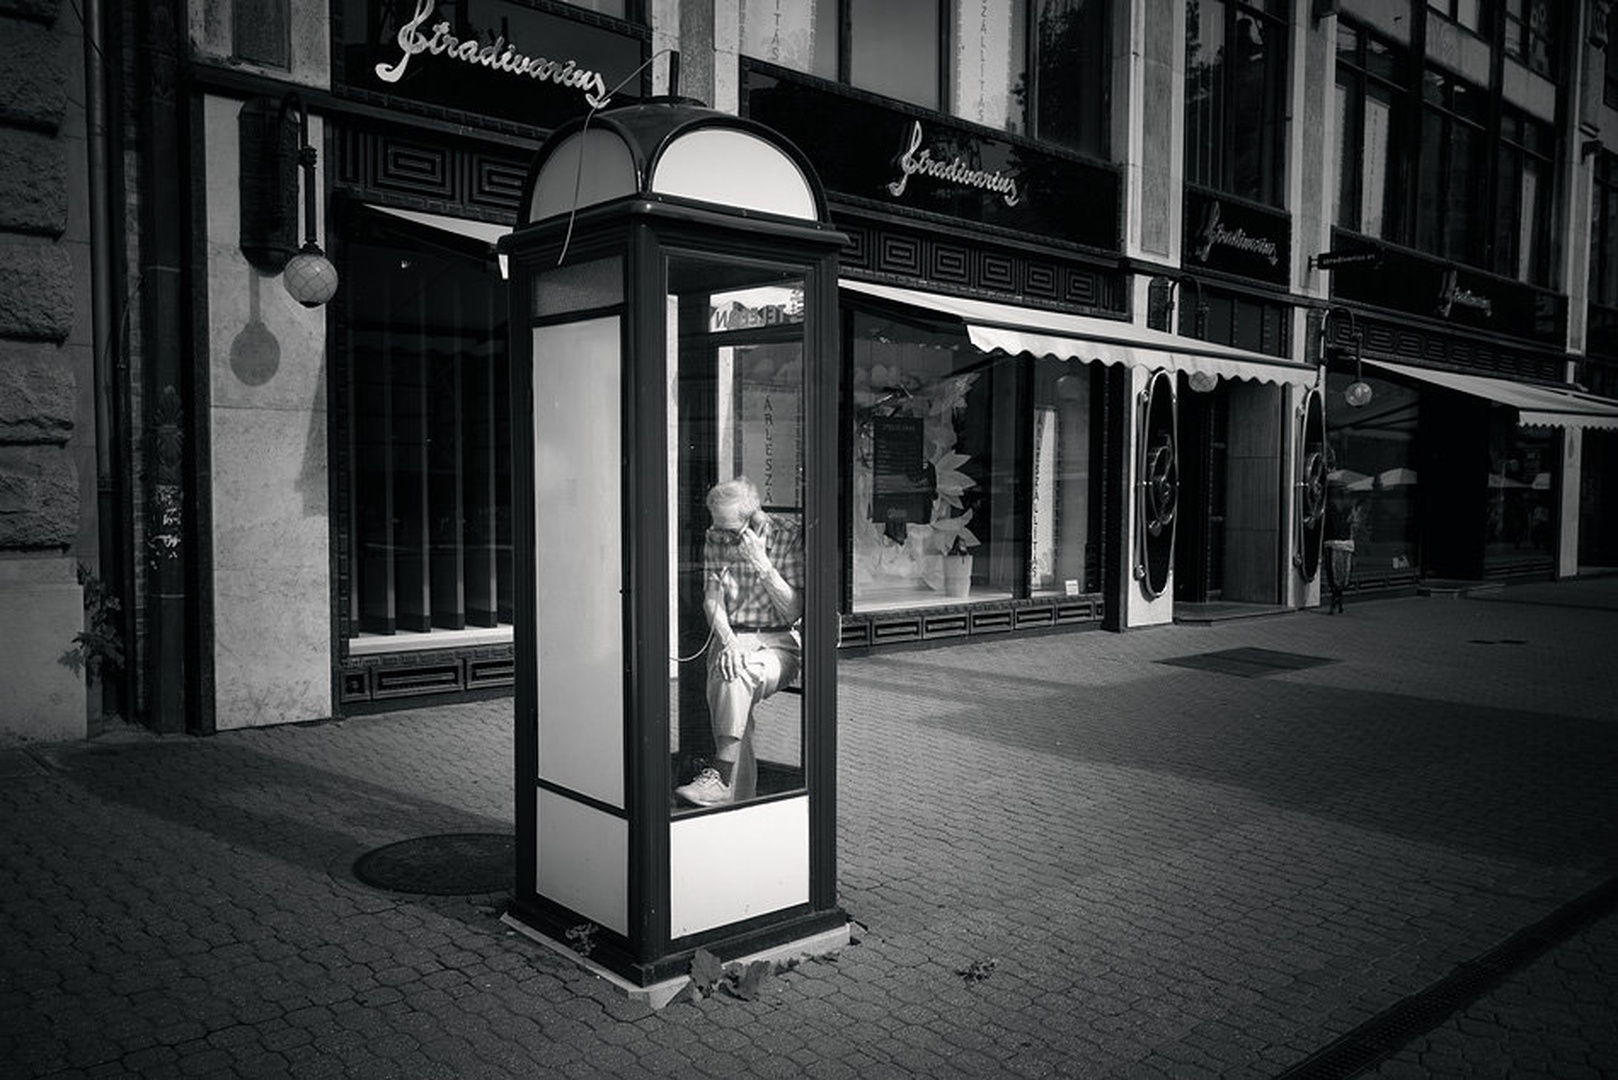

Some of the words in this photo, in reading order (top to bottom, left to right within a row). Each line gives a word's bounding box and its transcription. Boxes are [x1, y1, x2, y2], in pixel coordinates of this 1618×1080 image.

[374, 0, 611, 109] Stradivarius
[885, 119, 1020, 208] Stradivarius
[1194, 200, 1279, 266] Stradivarius
